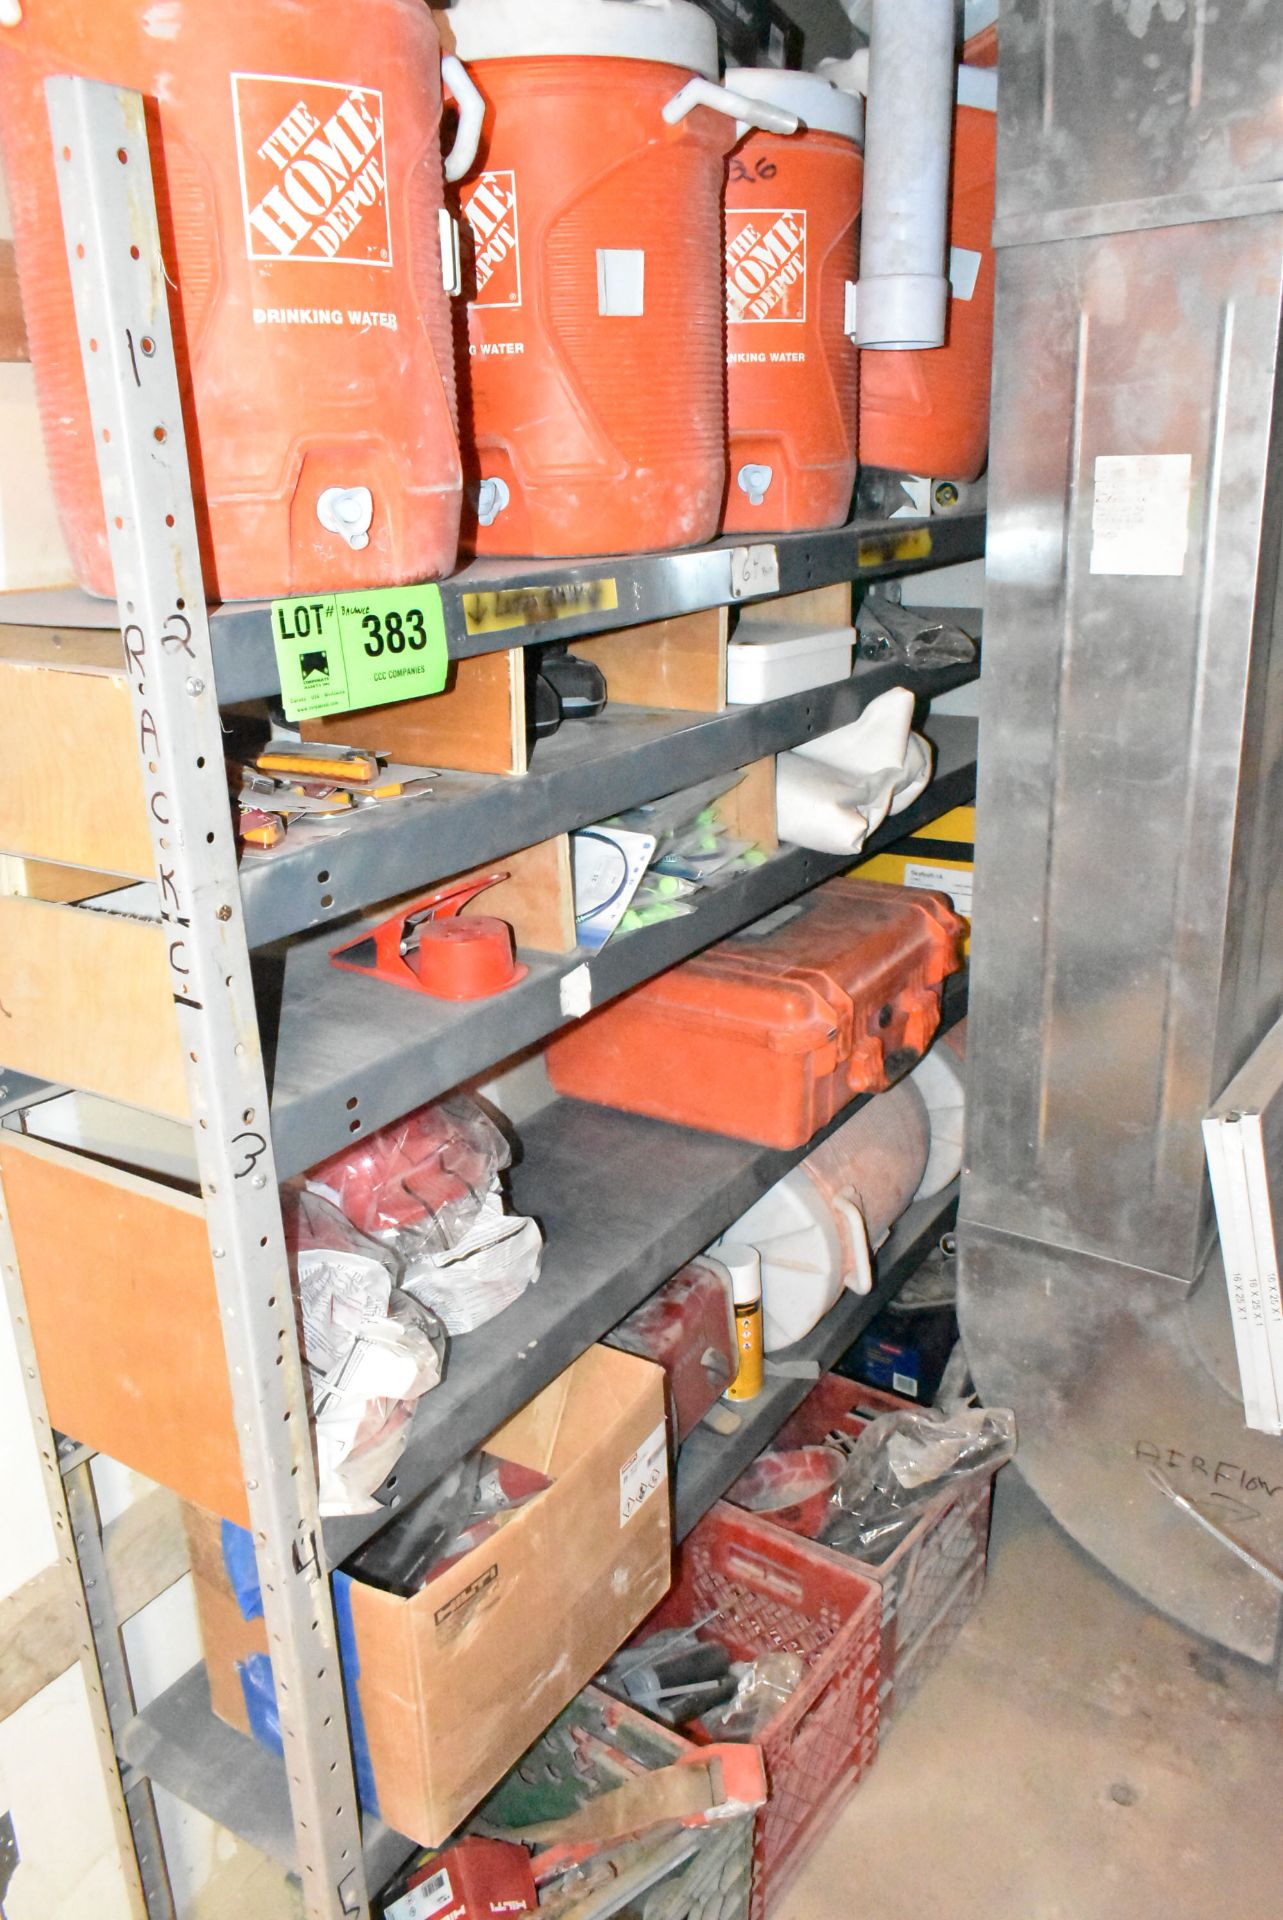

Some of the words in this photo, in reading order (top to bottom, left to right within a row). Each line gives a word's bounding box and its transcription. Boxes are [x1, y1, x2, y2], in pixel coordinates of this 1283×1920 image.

[257, 100, 321, 170] THE
[249, 90, 382, 256] HOME
[310, 156, 384, 258] DEPOT
[475, 222, 517, 293] EPOT
[750, 252, 805, 320] DEPOT
[253, 308, 343, 324] DRINKING
[347, 311, 397, 328] WATER
[480, 343, 524, 354] WATER
[770, 352, 806, 363] WATER
[361, 609, 427, 657] 383
[373, 672, 387, 682] CCC
[388, 665, 426, 680] COMPANIES
[231, 1132, 266, 1179] 3
